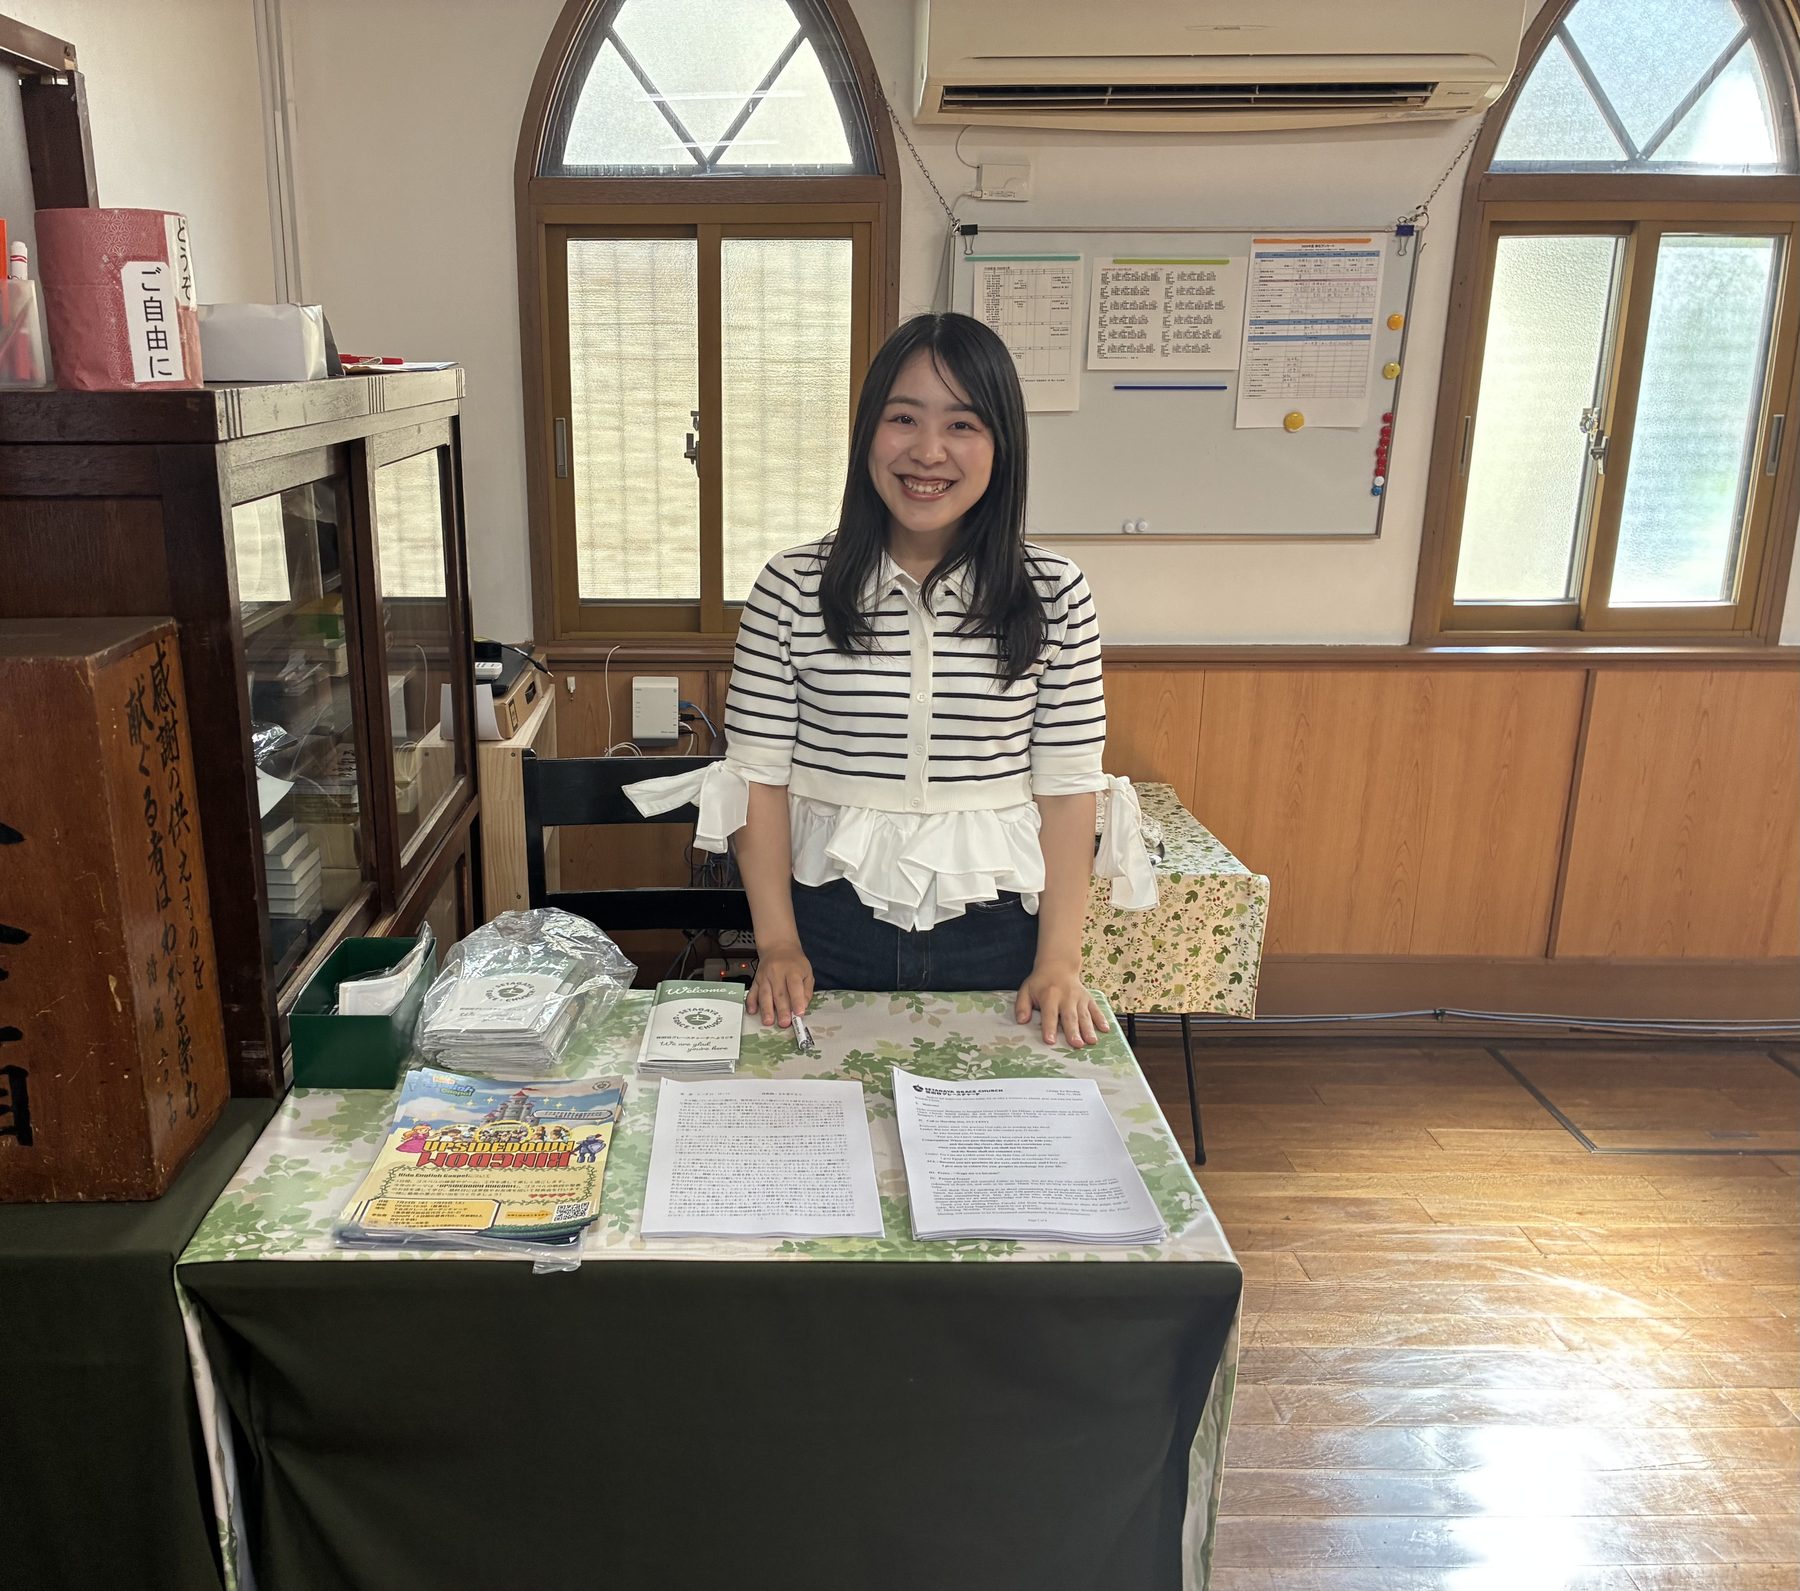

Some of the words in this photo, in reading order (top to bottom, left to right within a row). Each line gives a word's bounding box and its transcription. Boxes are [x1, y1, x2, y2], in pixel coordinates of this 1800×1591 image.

[141, 266, 173, 379] ご自由に
[665, 986, 727, 995] Welcome
